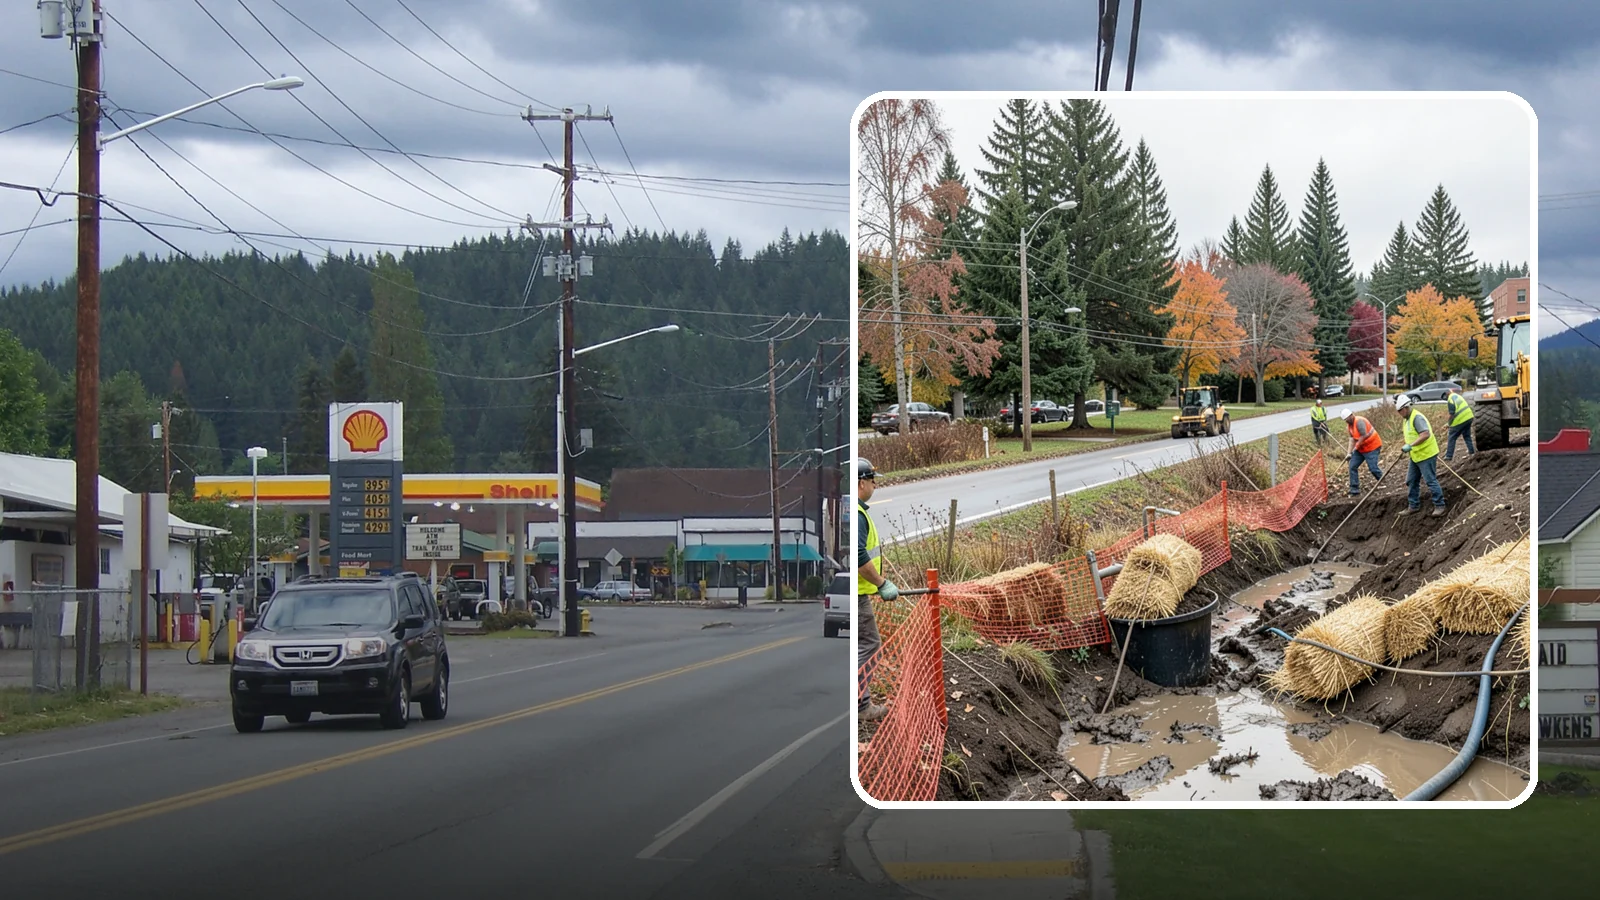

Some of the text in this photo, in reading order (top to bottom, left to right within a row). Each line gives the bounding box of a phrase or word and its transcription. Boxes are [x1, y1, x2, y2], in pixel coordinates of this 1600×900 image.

[366, 480, 383, 490] 395
[490, 484, 547, 499] Shell
[366, 494, 383, 504] 405
[366, 508, 383, 518] 415
[366, 522, 383, 532] 429
